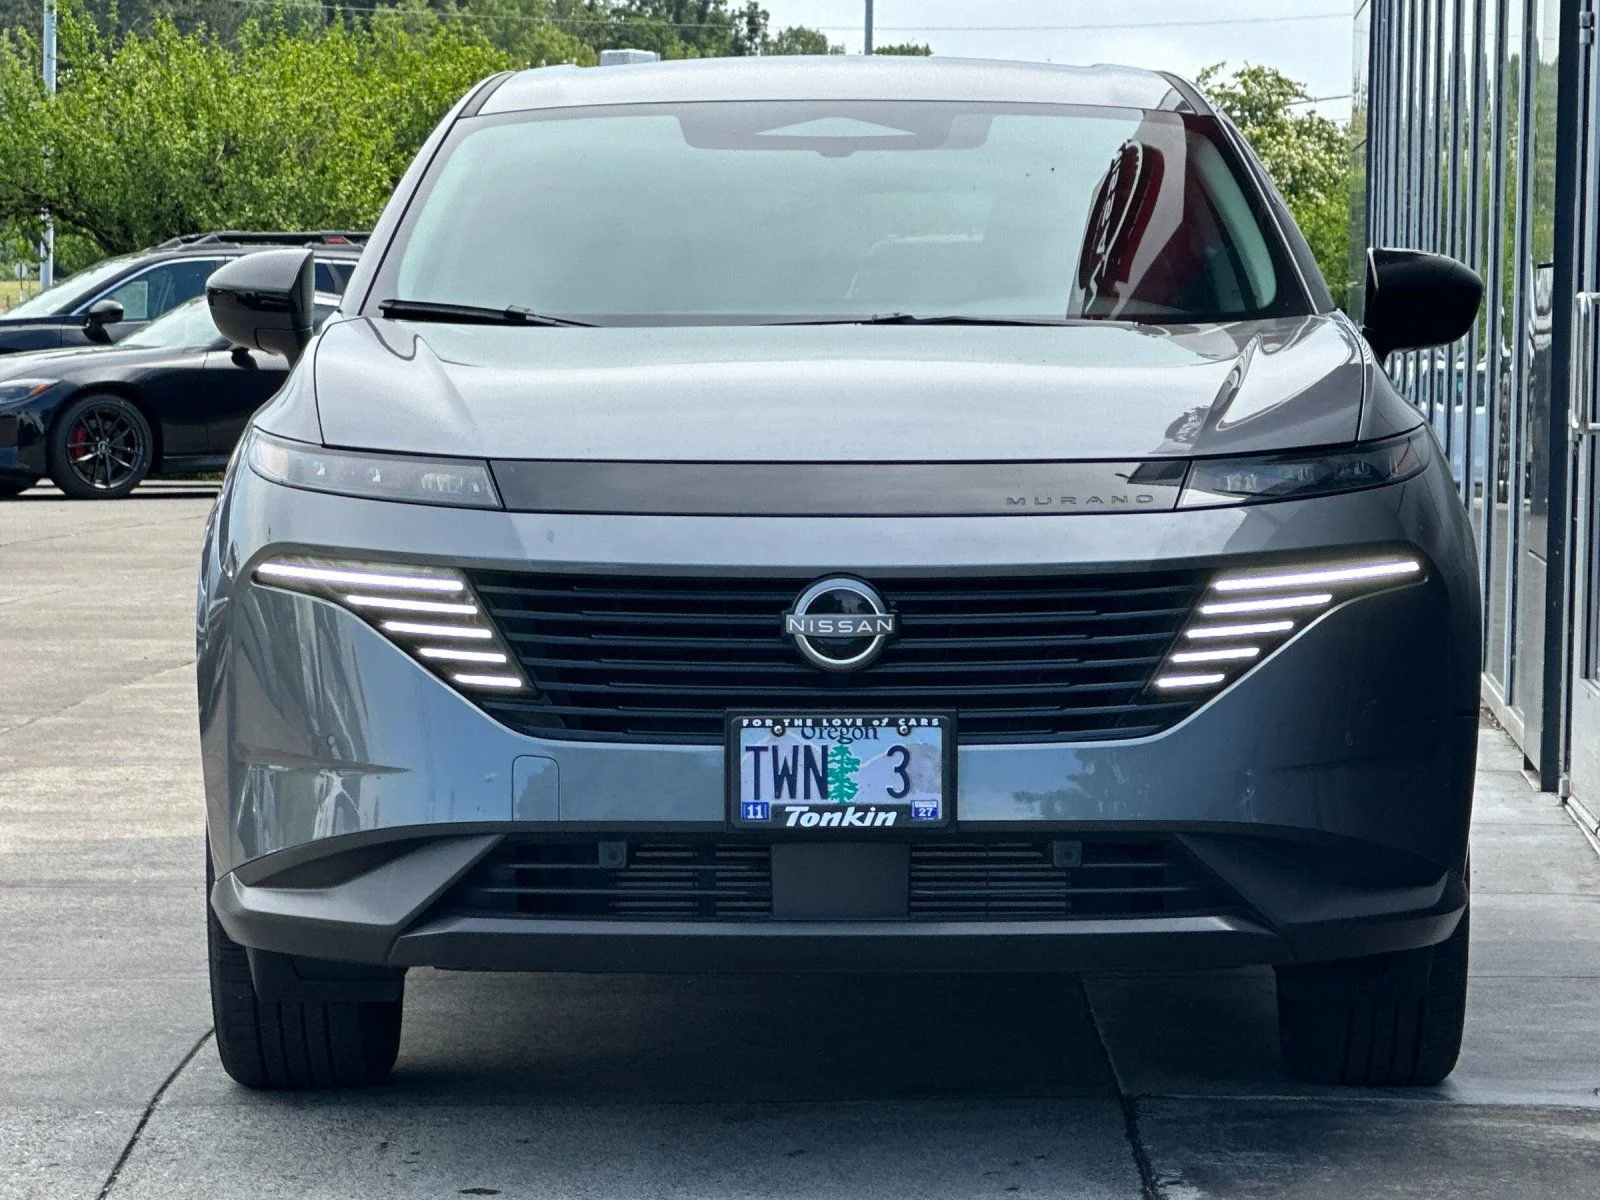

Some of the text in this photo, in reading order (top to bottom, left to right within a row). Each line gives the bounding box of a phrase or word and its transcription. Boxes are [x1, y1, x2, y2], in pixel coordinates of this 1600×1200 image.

[1006, 494, 1154, 507] MURANO
[789, 618, 893, 633] NISSAN
[742, 718, 774, 727] FOR
[783, 718, 813, 727] THE
[822, 718, 863, 727] LOVE
[898, 718, 939, 727] CARS
[801, 726, 879, 744] Oregon
[745, 745, 911, 800] TWN 3
[747, 804, 764, 819] 11
[784, 806, 897, 827] Tonkin
[918, 807, 934, 817] 27
